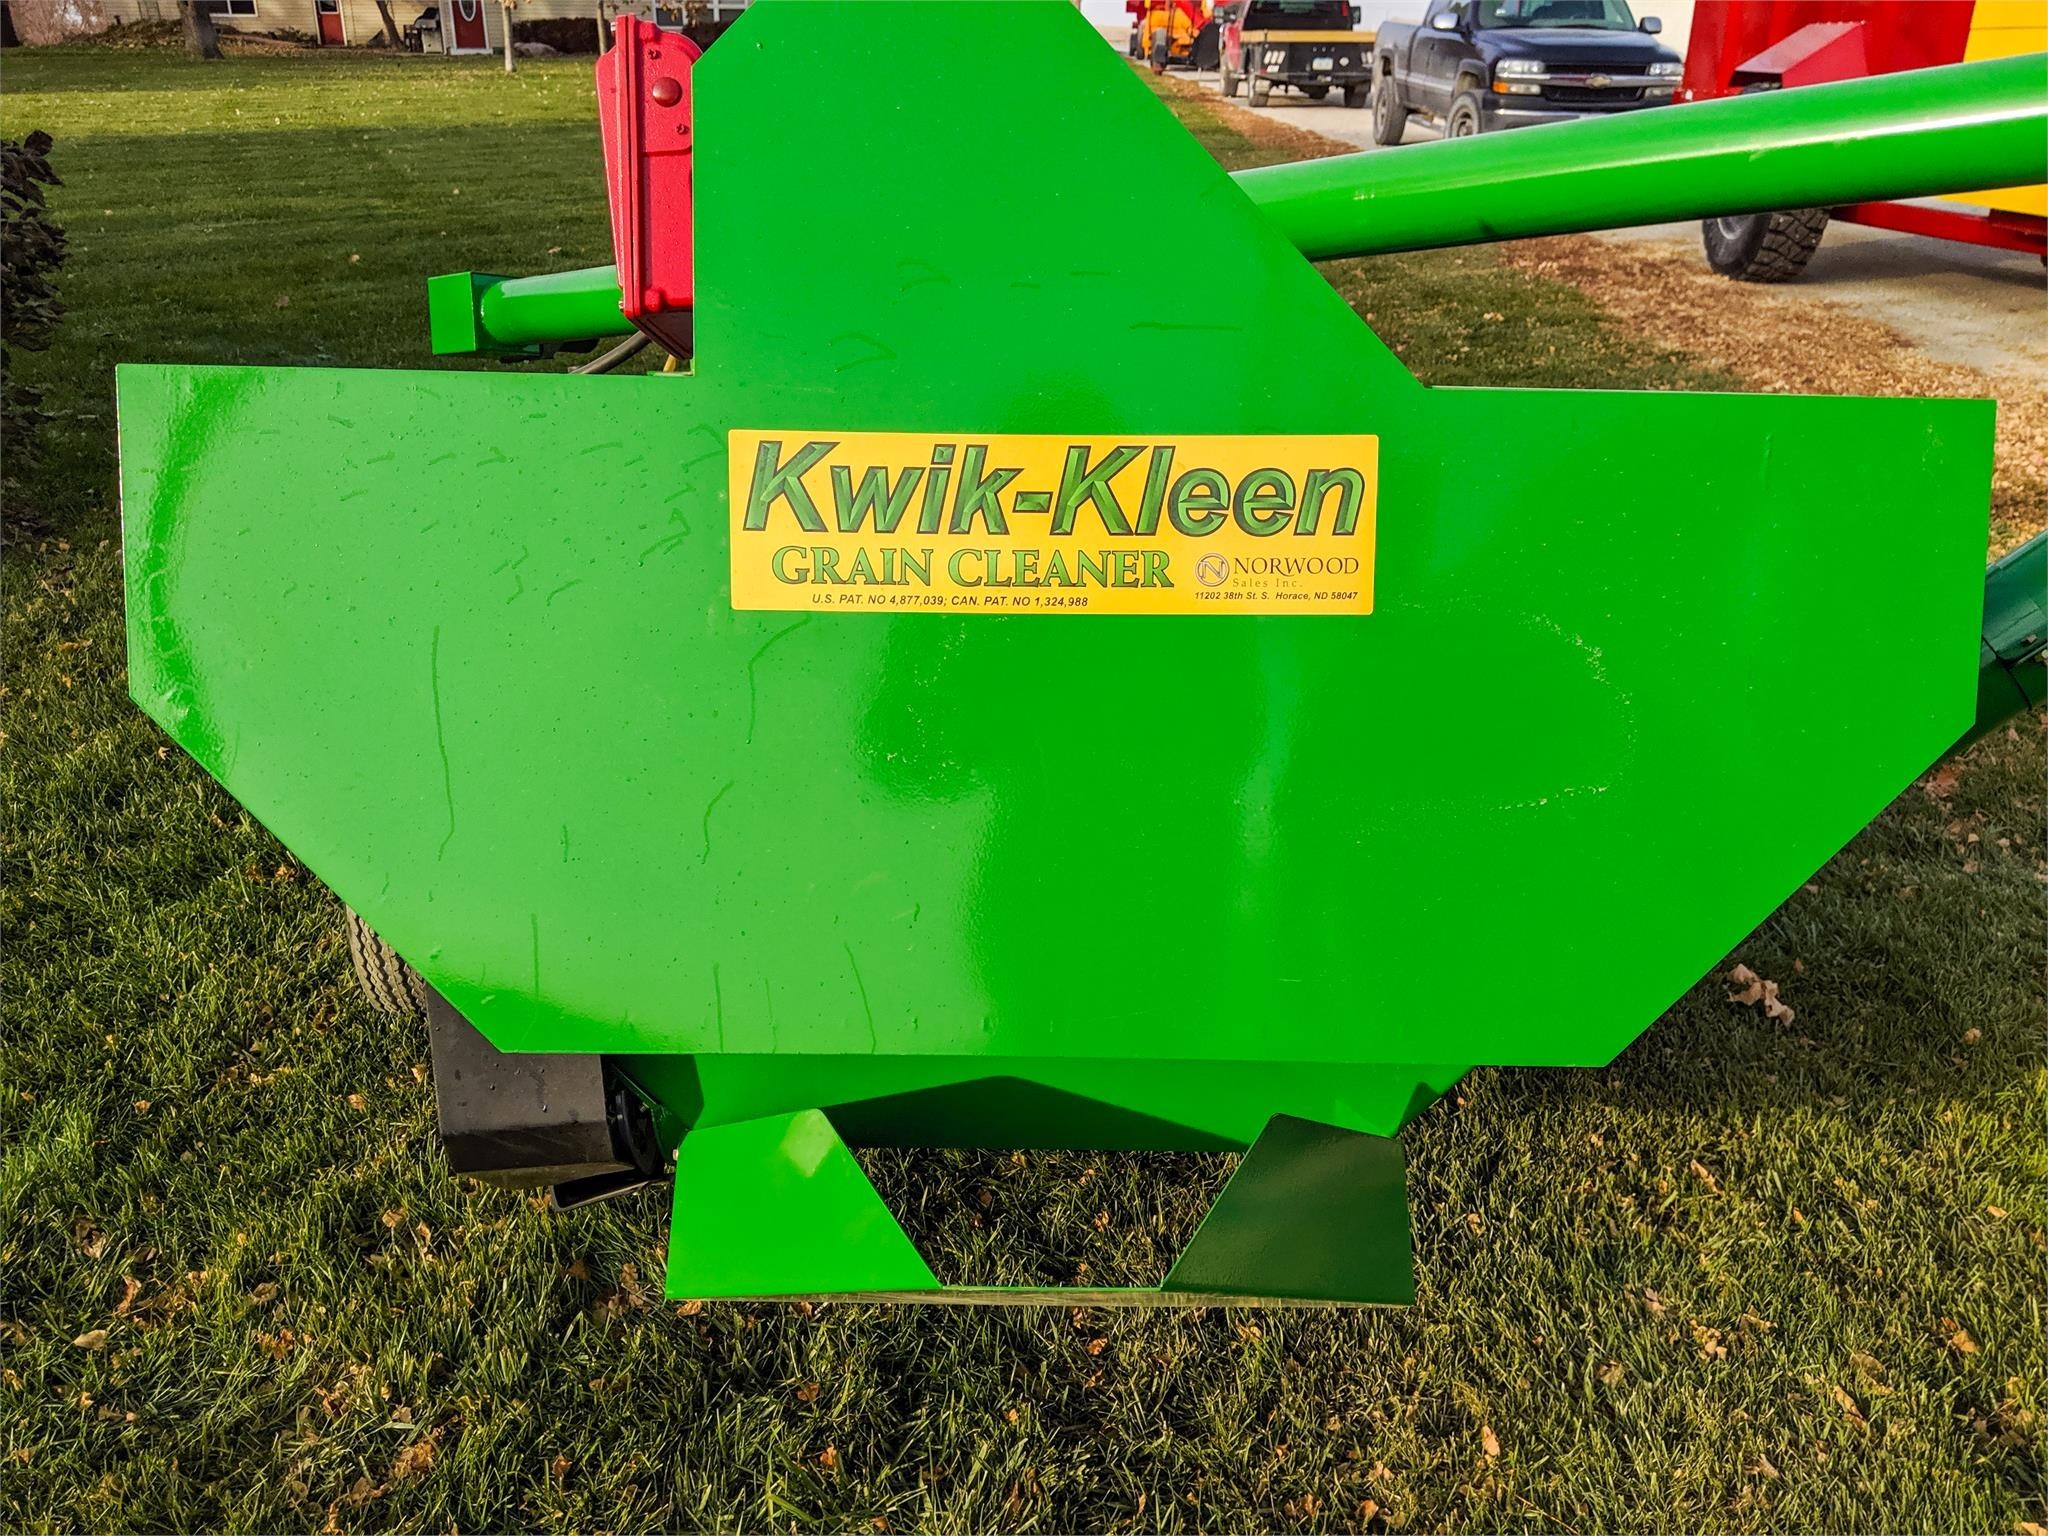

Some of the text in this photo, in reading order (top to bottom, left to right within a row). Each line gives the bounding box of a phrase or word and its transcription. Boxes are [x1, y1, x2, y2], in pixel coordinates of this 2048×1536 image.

[743, 440, 1366, 537] Kwik-Kleen
[771, 545, 1175, 588] GRAIN CLEANER
[1234, 556, 1360, 578] NORWOOD
[1232, 577, 1303, 588] Sales Inc.
[812, 593, 1089, 608] U.S. PAT. NO 4,877,039; CAN. PAT. NO 1,324,988
[1194, 591, 1359, 601] 11202 38th St. S. Horace, ND 58047
